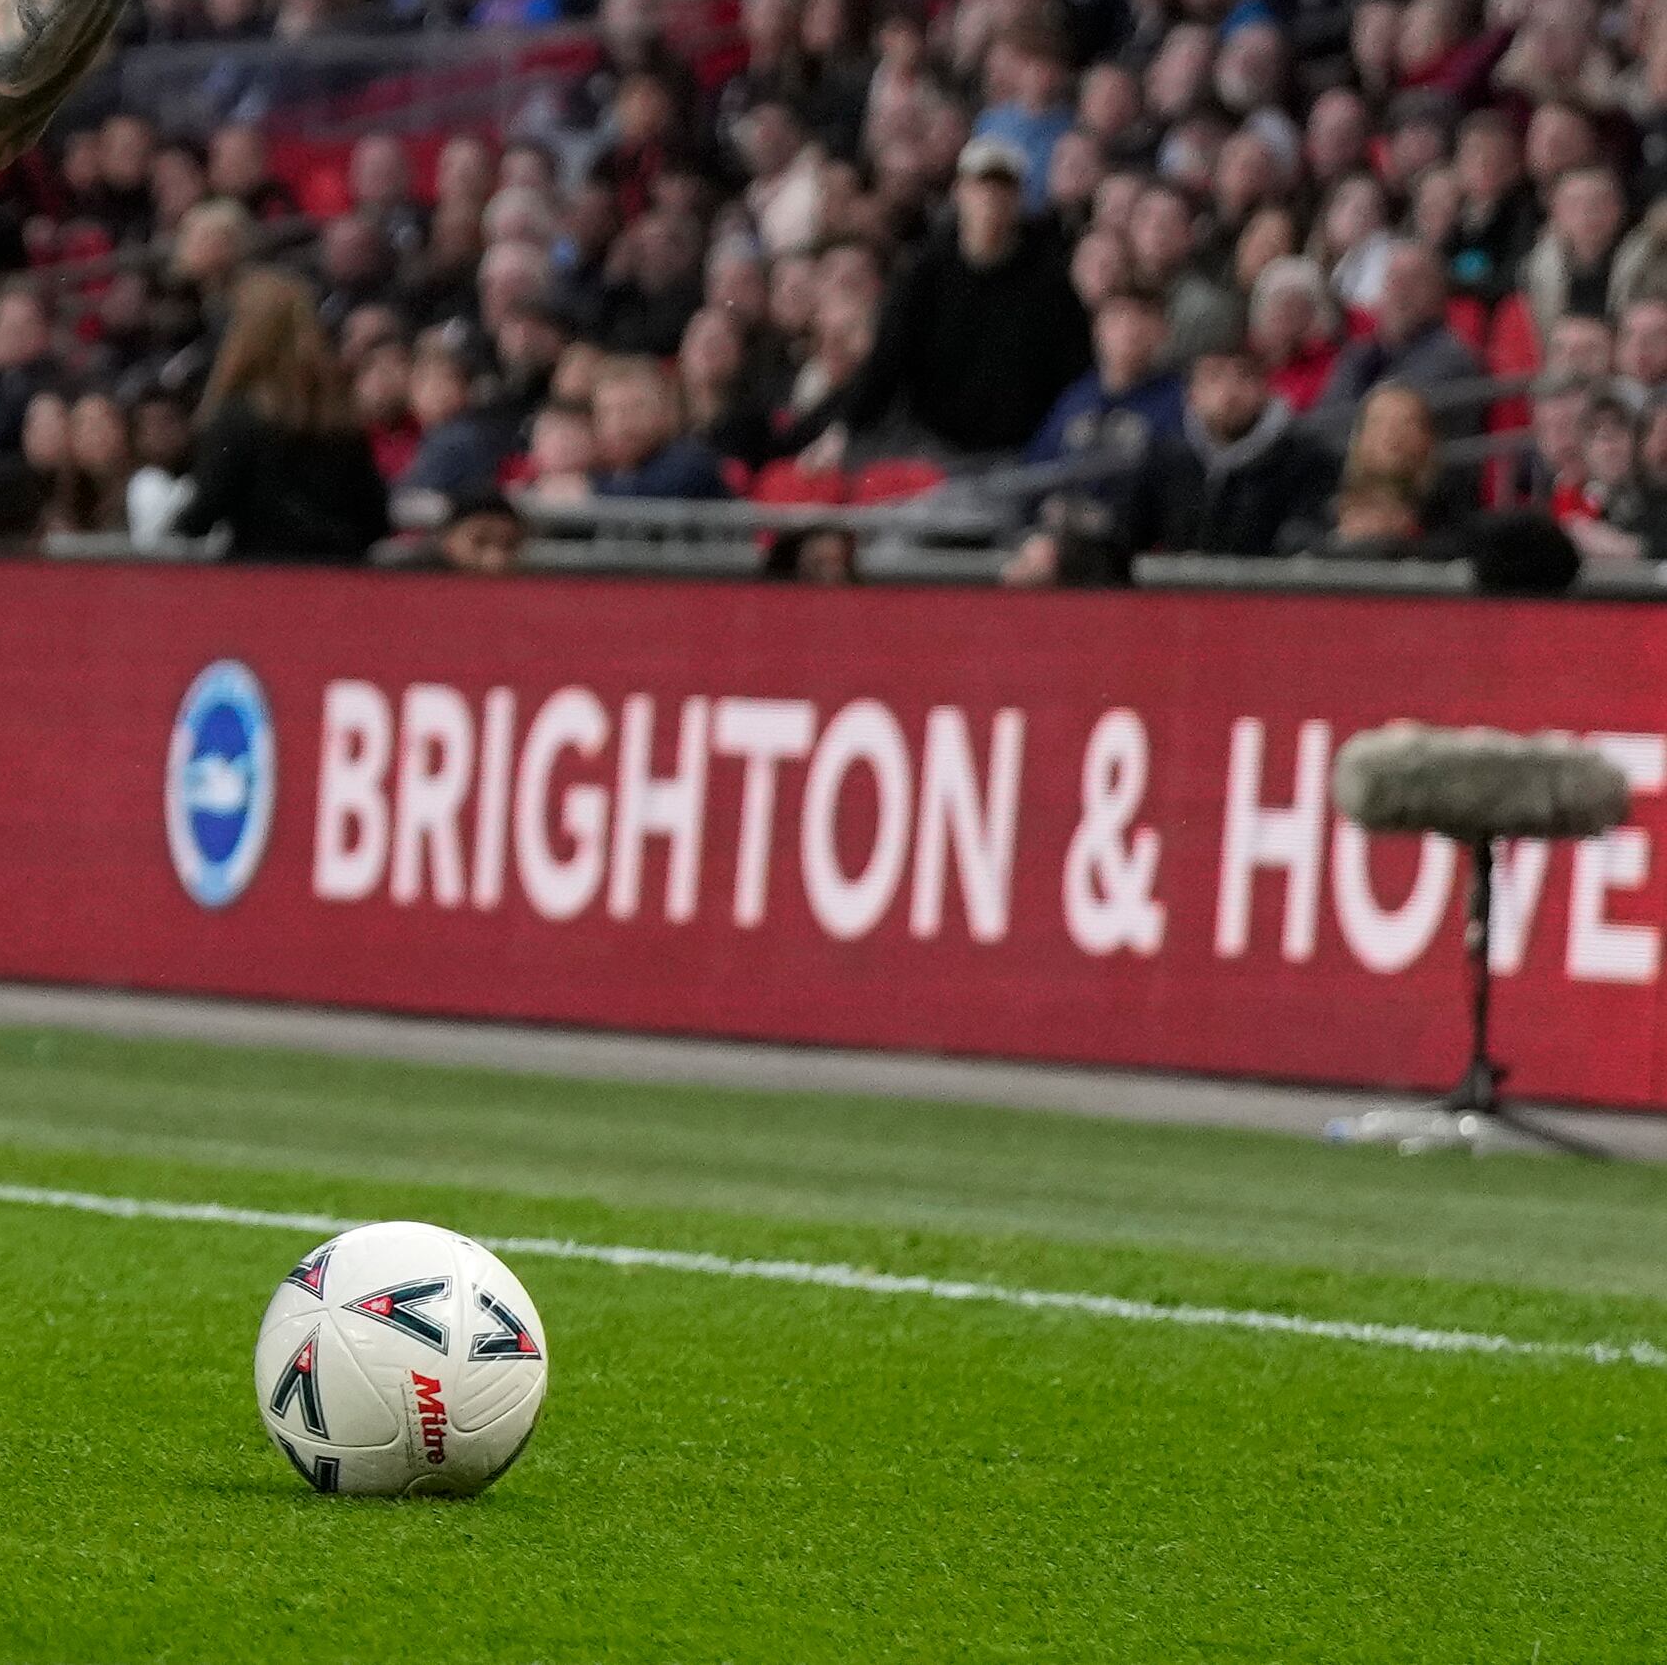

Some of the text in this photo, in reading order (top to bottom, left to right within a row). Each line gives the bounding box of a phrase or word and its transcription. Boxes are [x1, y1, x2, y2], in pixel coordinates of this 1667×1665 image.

[311, 679, 1027, 944] BRIGHTON
[1065, 705, 1165, 958] &
[410, 1369, 448, 1465] Mitre
